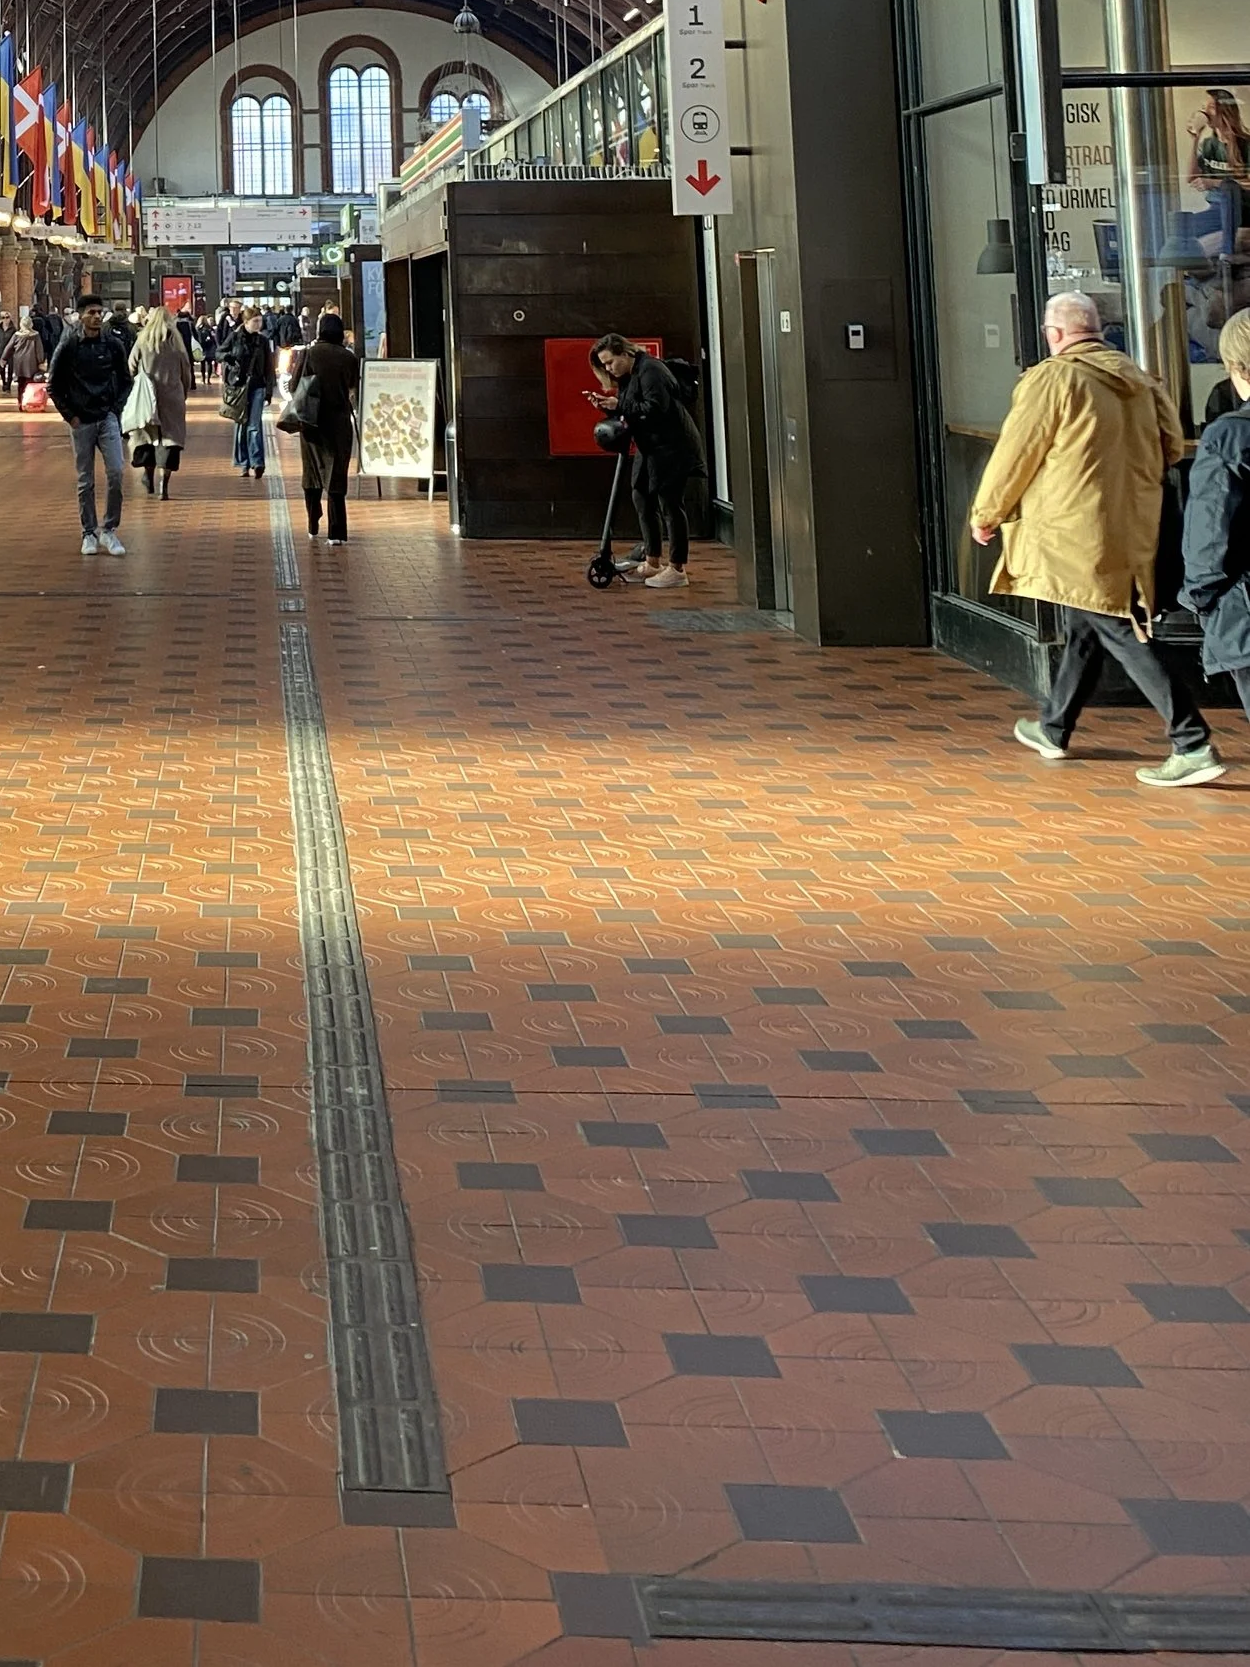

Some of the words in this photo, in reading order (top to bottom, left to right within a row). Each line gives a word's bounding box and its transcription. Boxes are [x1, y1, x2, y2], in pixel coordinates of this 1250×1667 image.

[688, 5, 704, 26] 1
[689, 58, 706, 79] 2
[1065, 102, 1101, 124] GISK
